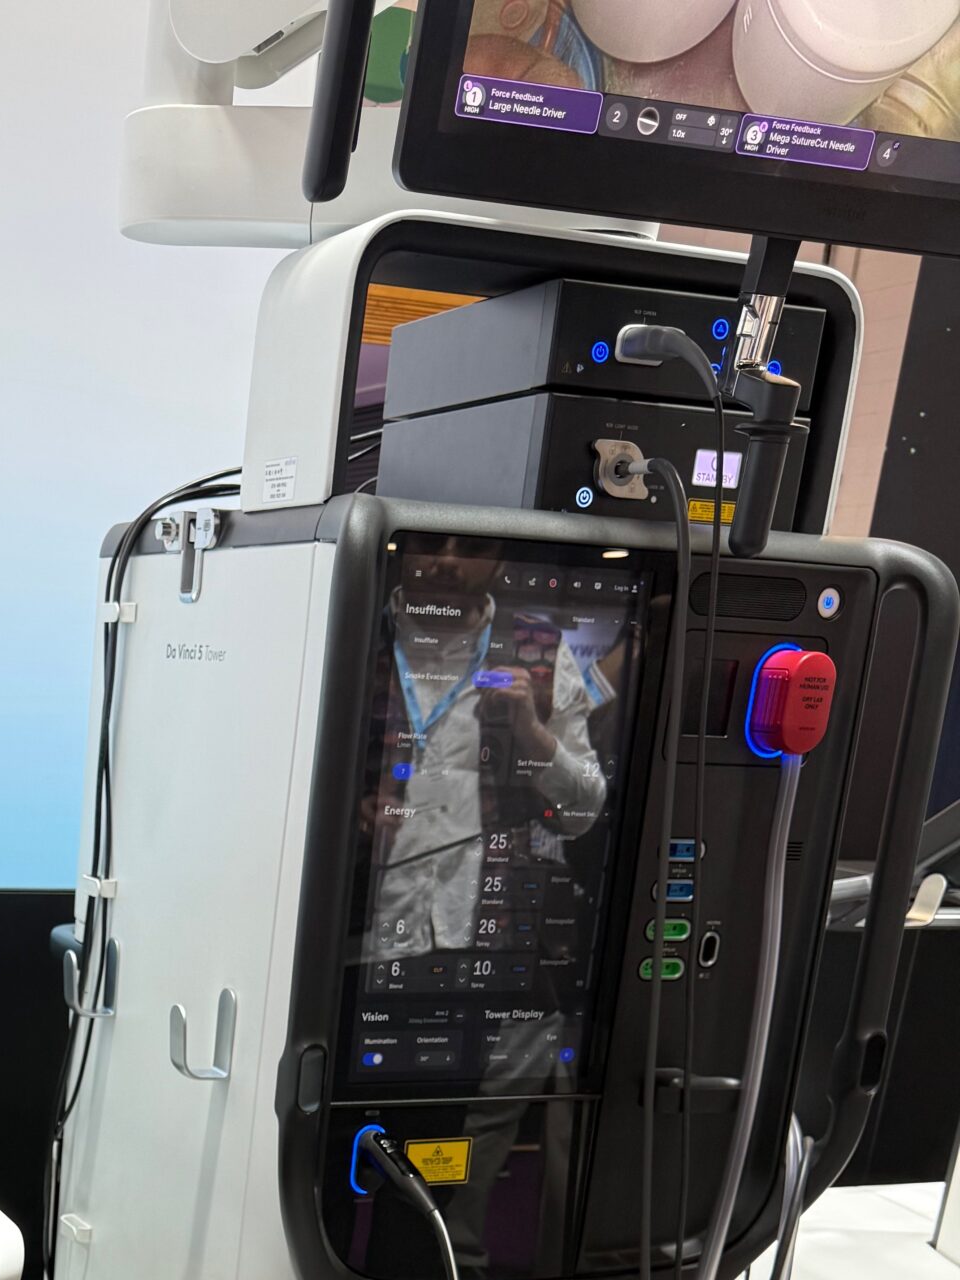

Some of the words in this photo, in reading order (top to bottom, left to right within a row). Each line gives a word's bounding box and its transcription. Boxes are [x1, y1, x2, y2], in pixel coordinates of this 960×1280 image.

[470, 91, 478, 104] 1
[491, 88, 510, 99] Force
[511, 90, 544, 103] Feedback
[464, 105, 480, 114] HIGH
[489, 101, 512, 114] Large
[513, 104, 541, 116] Needle
[542, 107, 567, 119] Driver
[612, 110, 621, 123] 2
[675, 112, 687, 121] OFF
[672, 129, 685, 139] 1.0x
[772, 121, 791, 132] Force
[791, 123, 821, 135] Feedback
[749, 130, 759, 142] 3
[770, 132, 791, 144] Mega
[791, 135, 828, 149] SutureCut
[829, 140, 856, 153] Needle
[744, 143, 759, 152] HIGH
[766, 144, 789, 156] Driver
[882, 147, 891, 160] 4
[696, 472, 734, 484] STANBY
[405, 603, 462, 617] Insufflation
[572, 616, 595, 624] Standard
[413, 636, 439, 645] Insufflate
[166, 643, 177, 660] Da
[177, 644, 198, 660] Vinci
[198, 645, 204, 661] 5
[204, 644, 227, 662] Tower
[404, 671, 426, 680] Smoke
[426, 672, 460, 681] Evacuation
[398, 732, 413, 740] Flow
[481, 746, 490, 762] 0
[518, 759, 528, 767] Set
[582, 762, 600, 778] 12
[384, 805, 417, 819] Energy
[489, 833, 508, 849] 25
[483, 876, 503, 892] 25
[395, 919, 406, 935] 6
[478, 918, 497, 934] 26
[390, 961, 401, 977] 6
[473, 959, 492, 976] 10
[361, 1011, 390, 1023] Vision
[483, 1008, 511, 1020] Tower
[511, 1008, 545, 1020] Display
[364, 1037, 398, 1045] Illumination
[416, 1036, 449, 1044] Orientation
